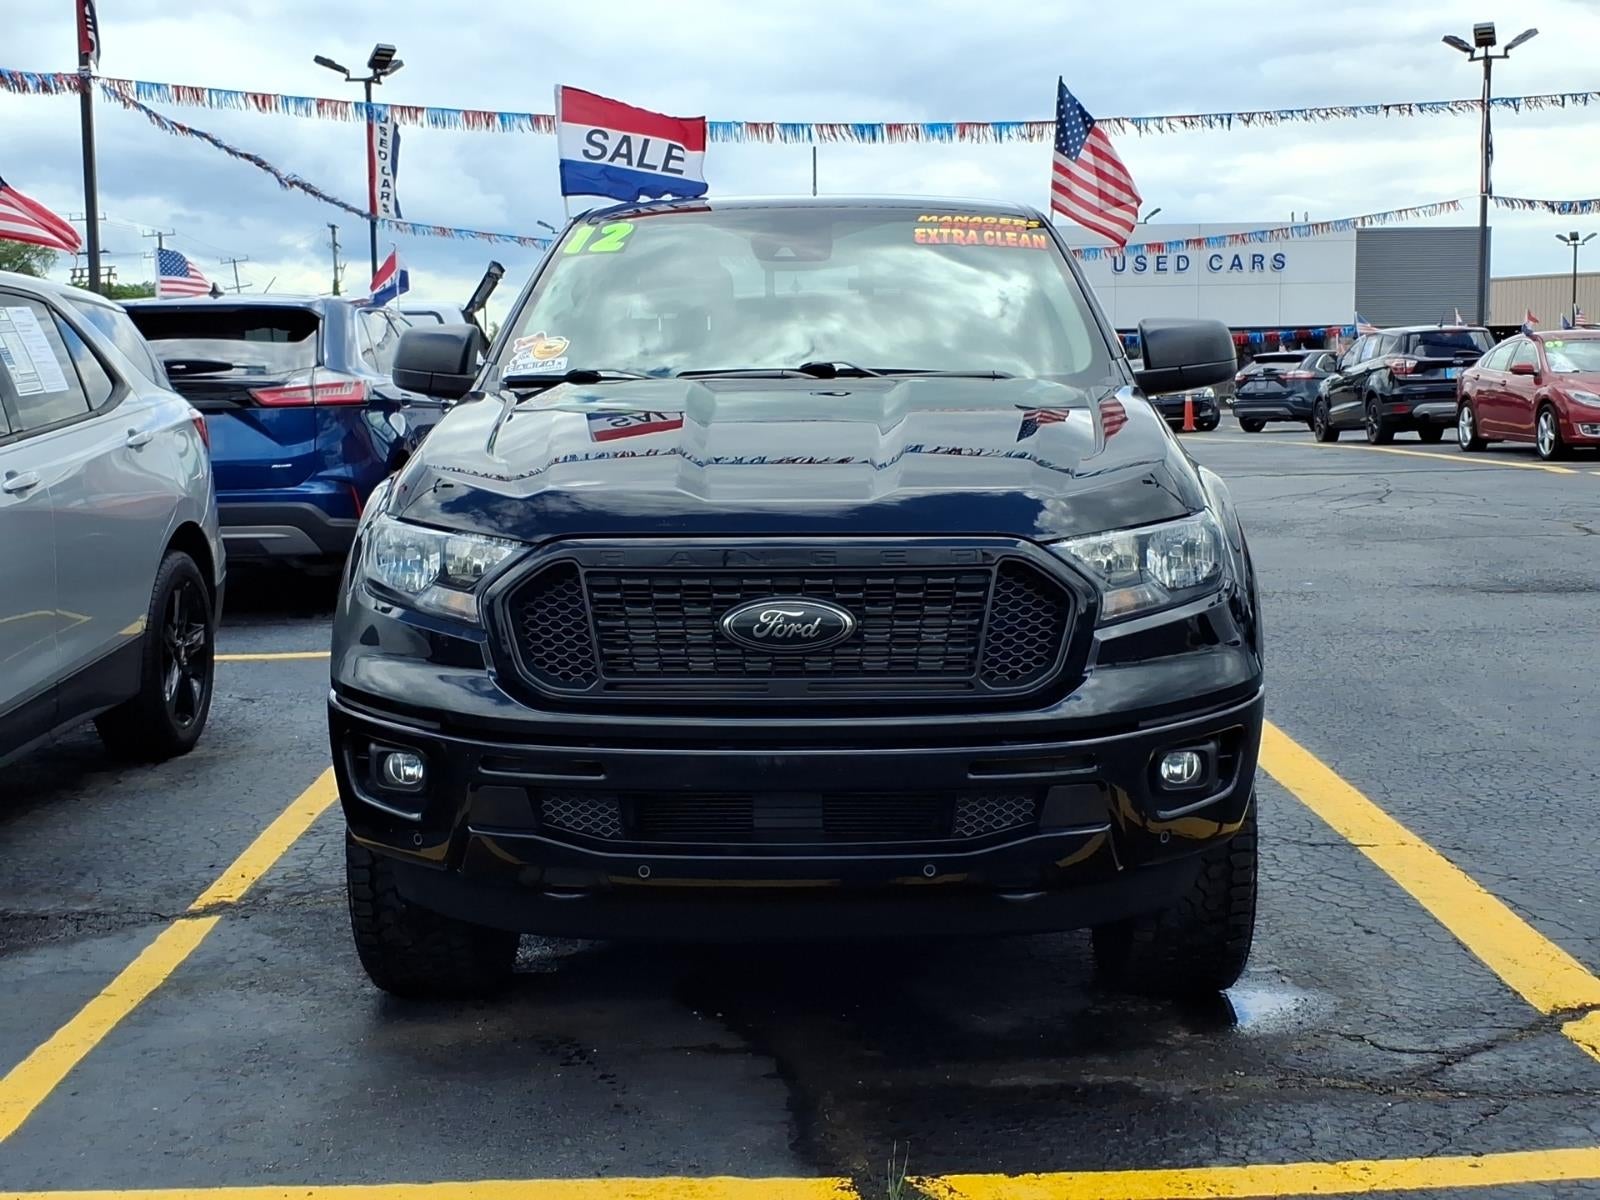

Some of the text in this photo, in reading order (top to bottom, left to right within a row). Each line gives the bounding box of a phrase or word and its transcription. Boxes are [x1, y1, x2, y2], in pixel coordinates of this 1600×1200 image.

[582, 128, 686, 175] SALE
[380, 166, 391, 213] CARS
[917, 215, 1040, 228] MANAGERS
[562, 222, 634, 254] 12
[914, 227, 1047, 249] EXTRA CLEAN
[1113, 252, 1286, 273] USED CARS
[599, 550, 984, 566] RANGER
[752, 609, 822, 639] Ford
